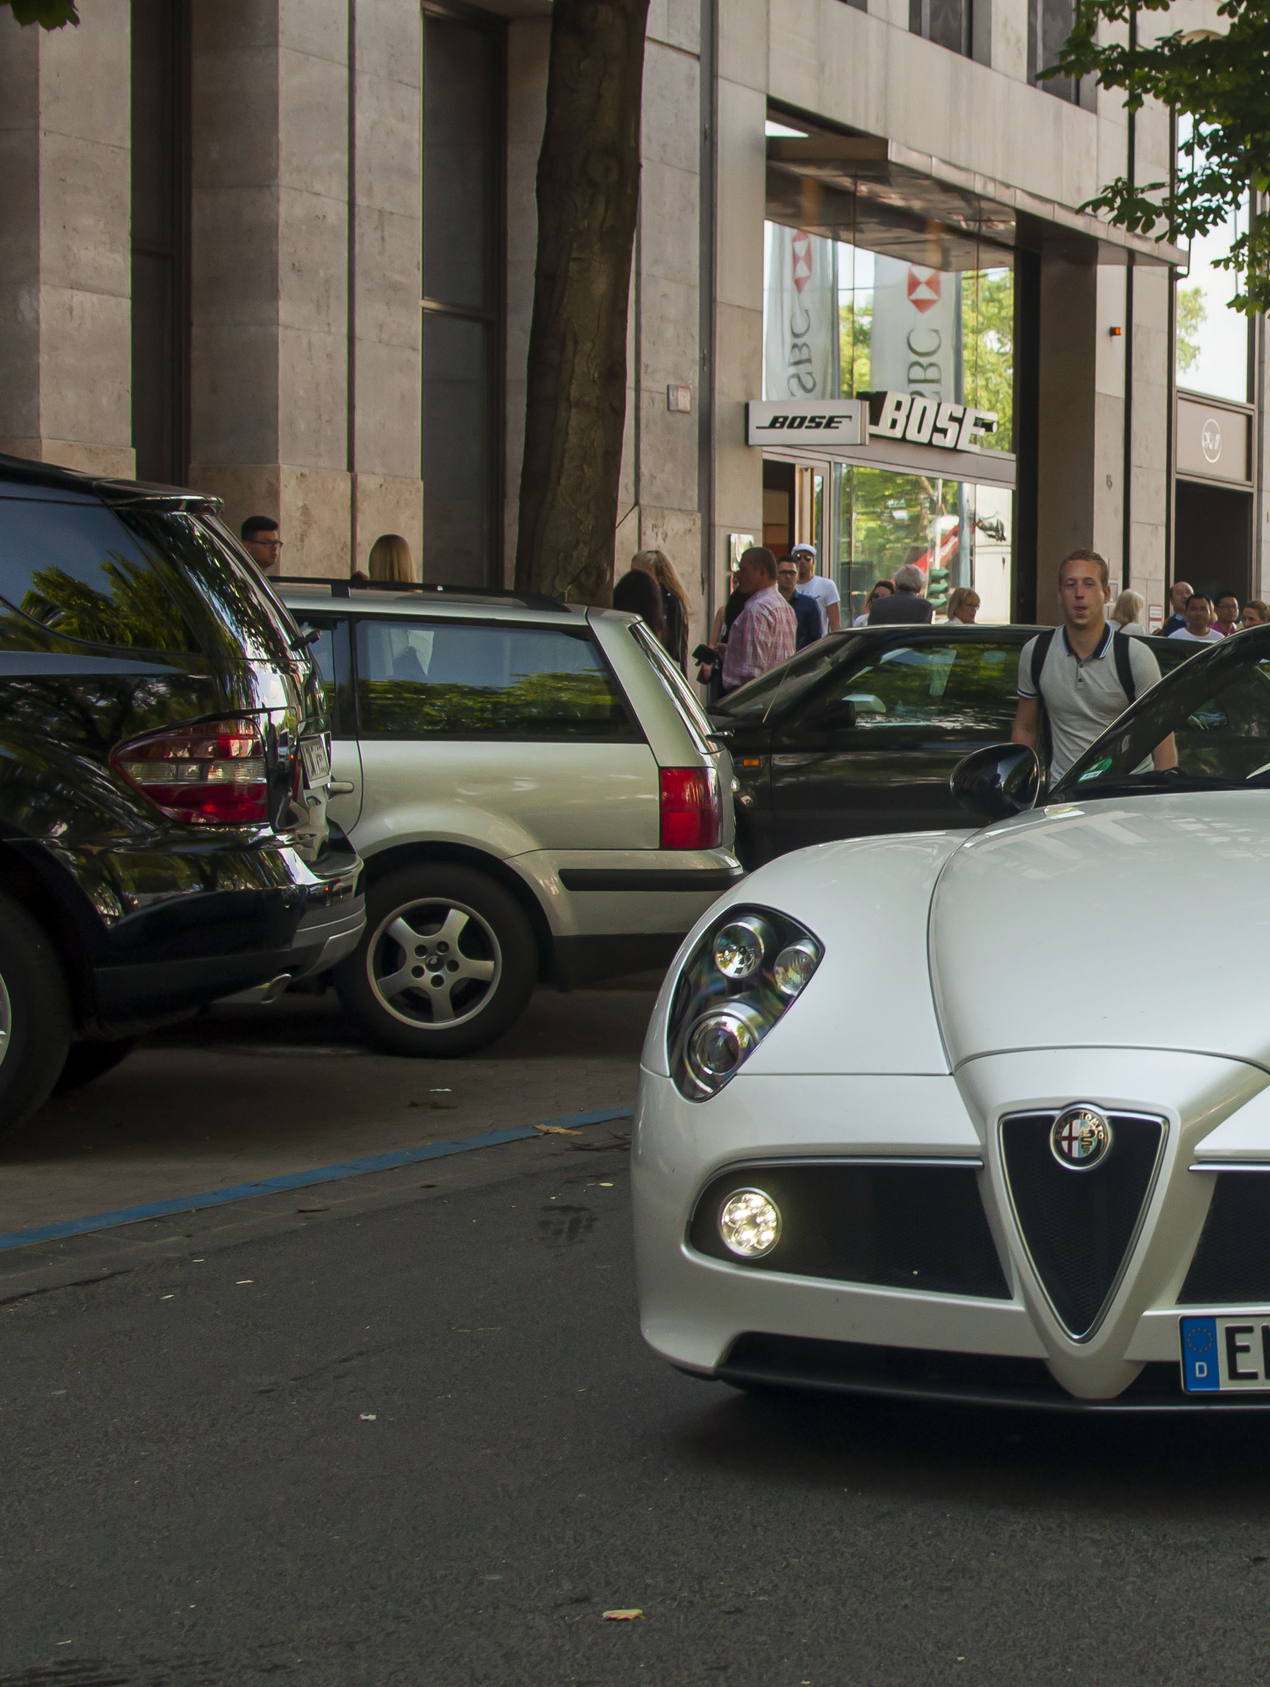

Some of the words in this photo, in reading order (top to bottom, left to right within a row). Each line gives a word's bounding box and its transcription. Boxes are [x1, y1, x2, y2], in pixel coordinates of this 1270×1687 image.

[756, 415, 853, 430] BOSE
[869, 391, 998, 453] BOSE
[1195, 1361, 1208, 1378] D
